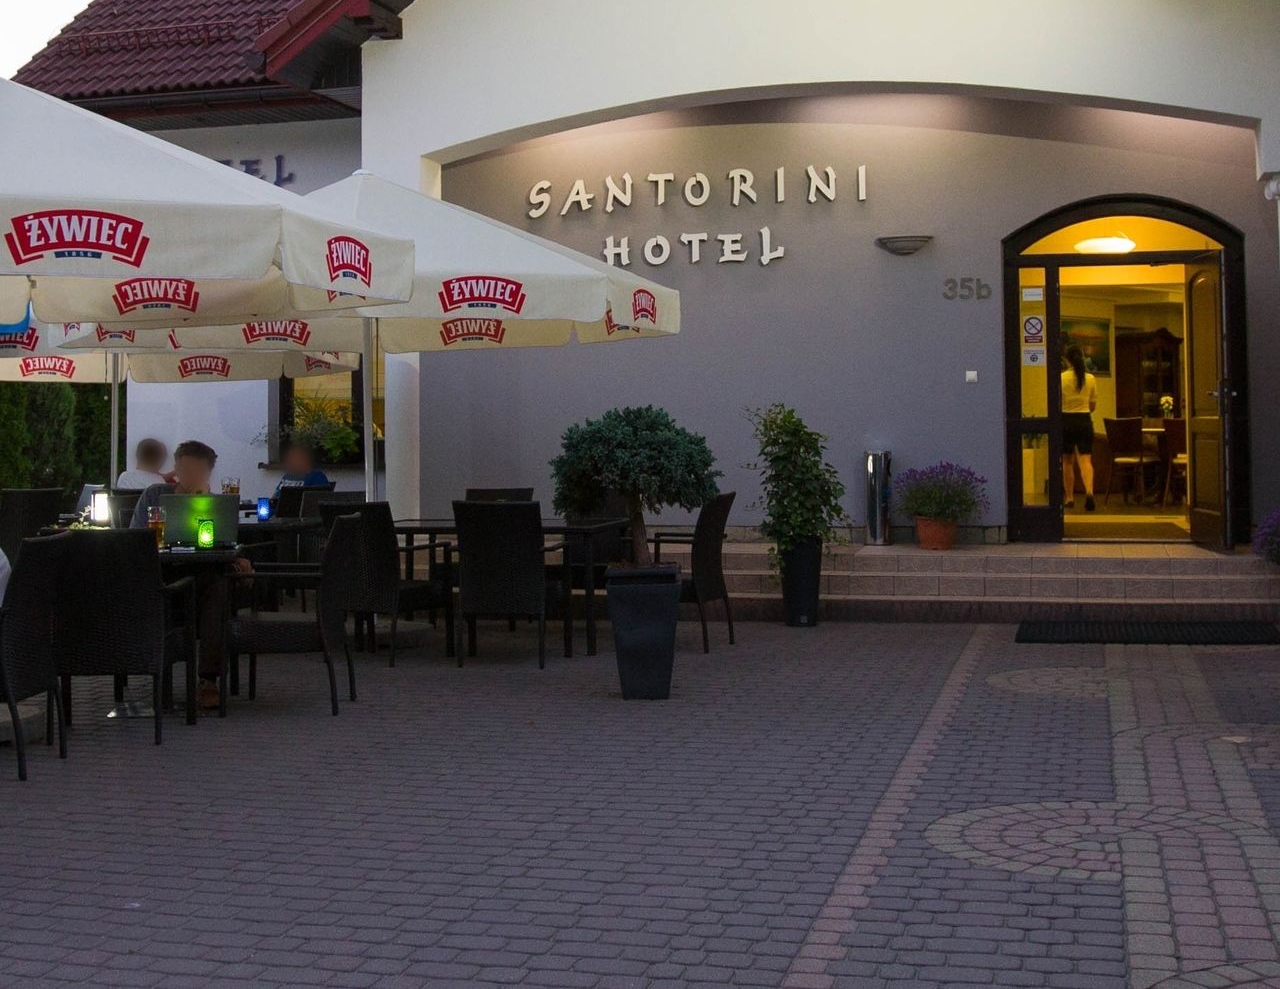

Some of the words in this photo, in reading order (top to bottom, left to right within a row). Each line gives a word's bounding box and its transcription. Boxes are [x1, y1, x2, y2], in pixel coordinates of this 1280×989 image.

[527, 164, 867, 219] SANTORINI
[23, 214, 134, 250] ŻYWIEC
[603, 226, 785, 266] HOTEL
[331, 239, 366, 273] ŻYWIEC
[450, 279, 516, 302] ŻYWIEC
[942, 277, 993, 300] 35b
